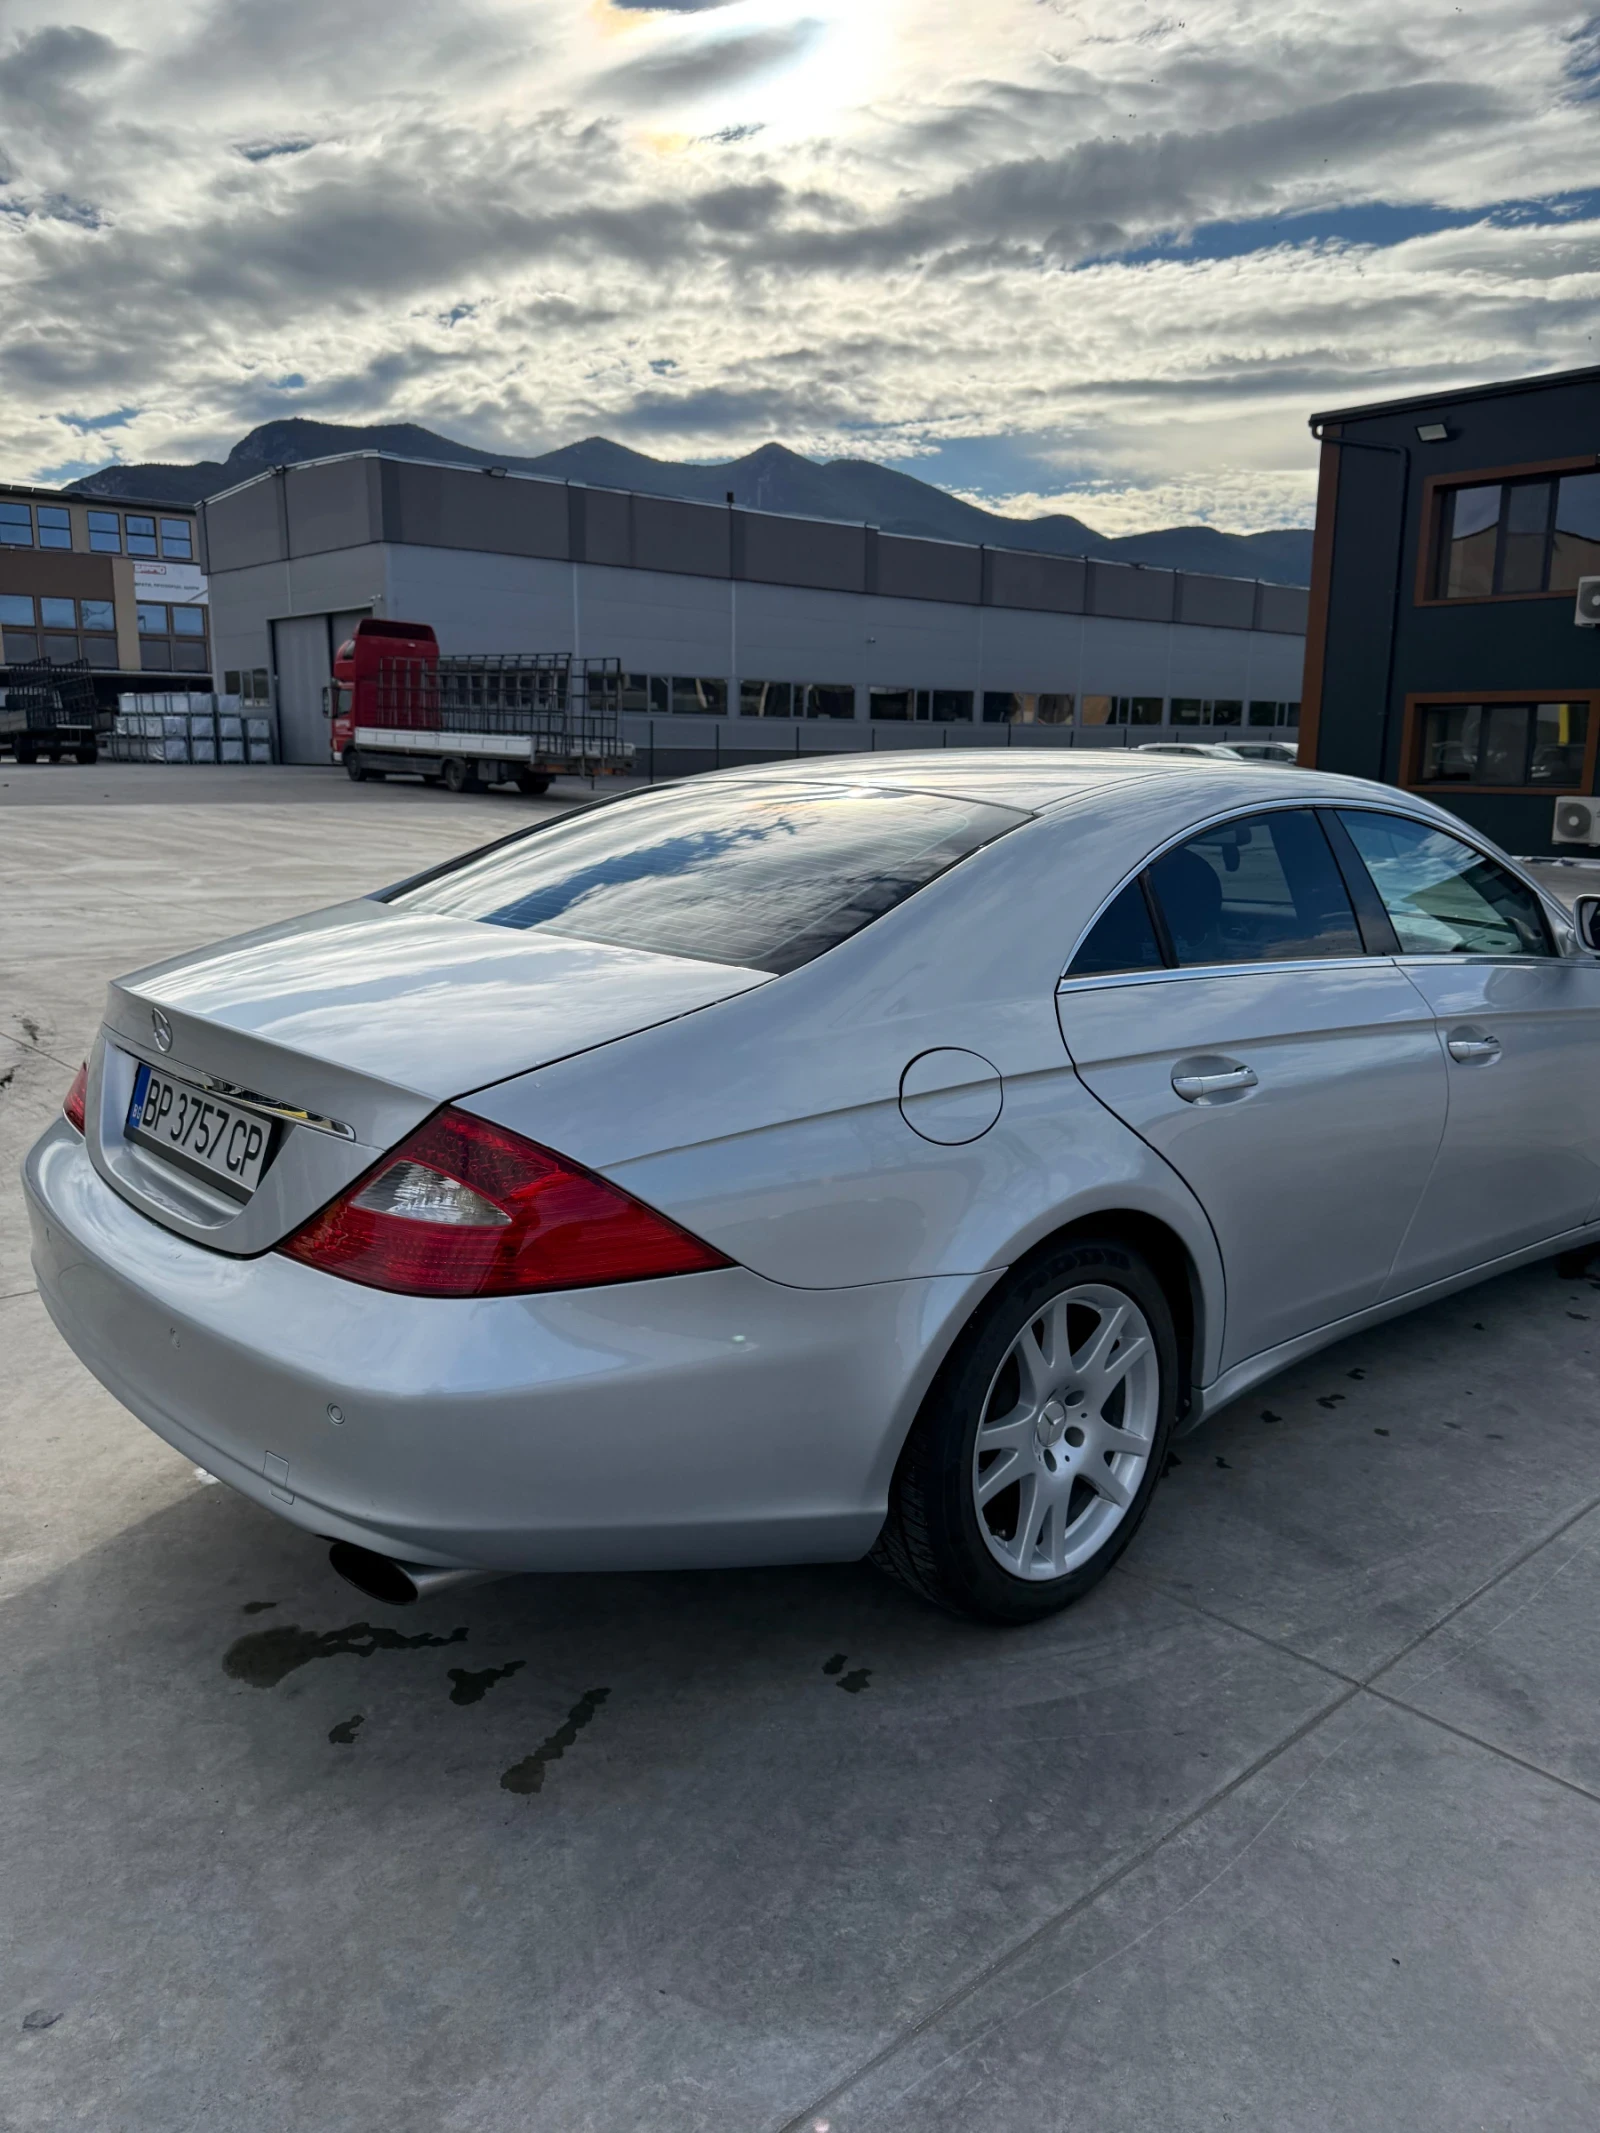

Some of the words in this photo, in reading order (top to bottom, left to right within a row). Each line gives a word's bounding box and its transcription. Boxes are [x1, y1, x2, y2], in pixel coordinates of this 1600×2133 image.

[132, 1103, 142, 1120] BG
[142, 1078, 173, 1131] BP
[170, 1093, 230, 1159] 3757
[226, 1119, 263, 1176] CP
